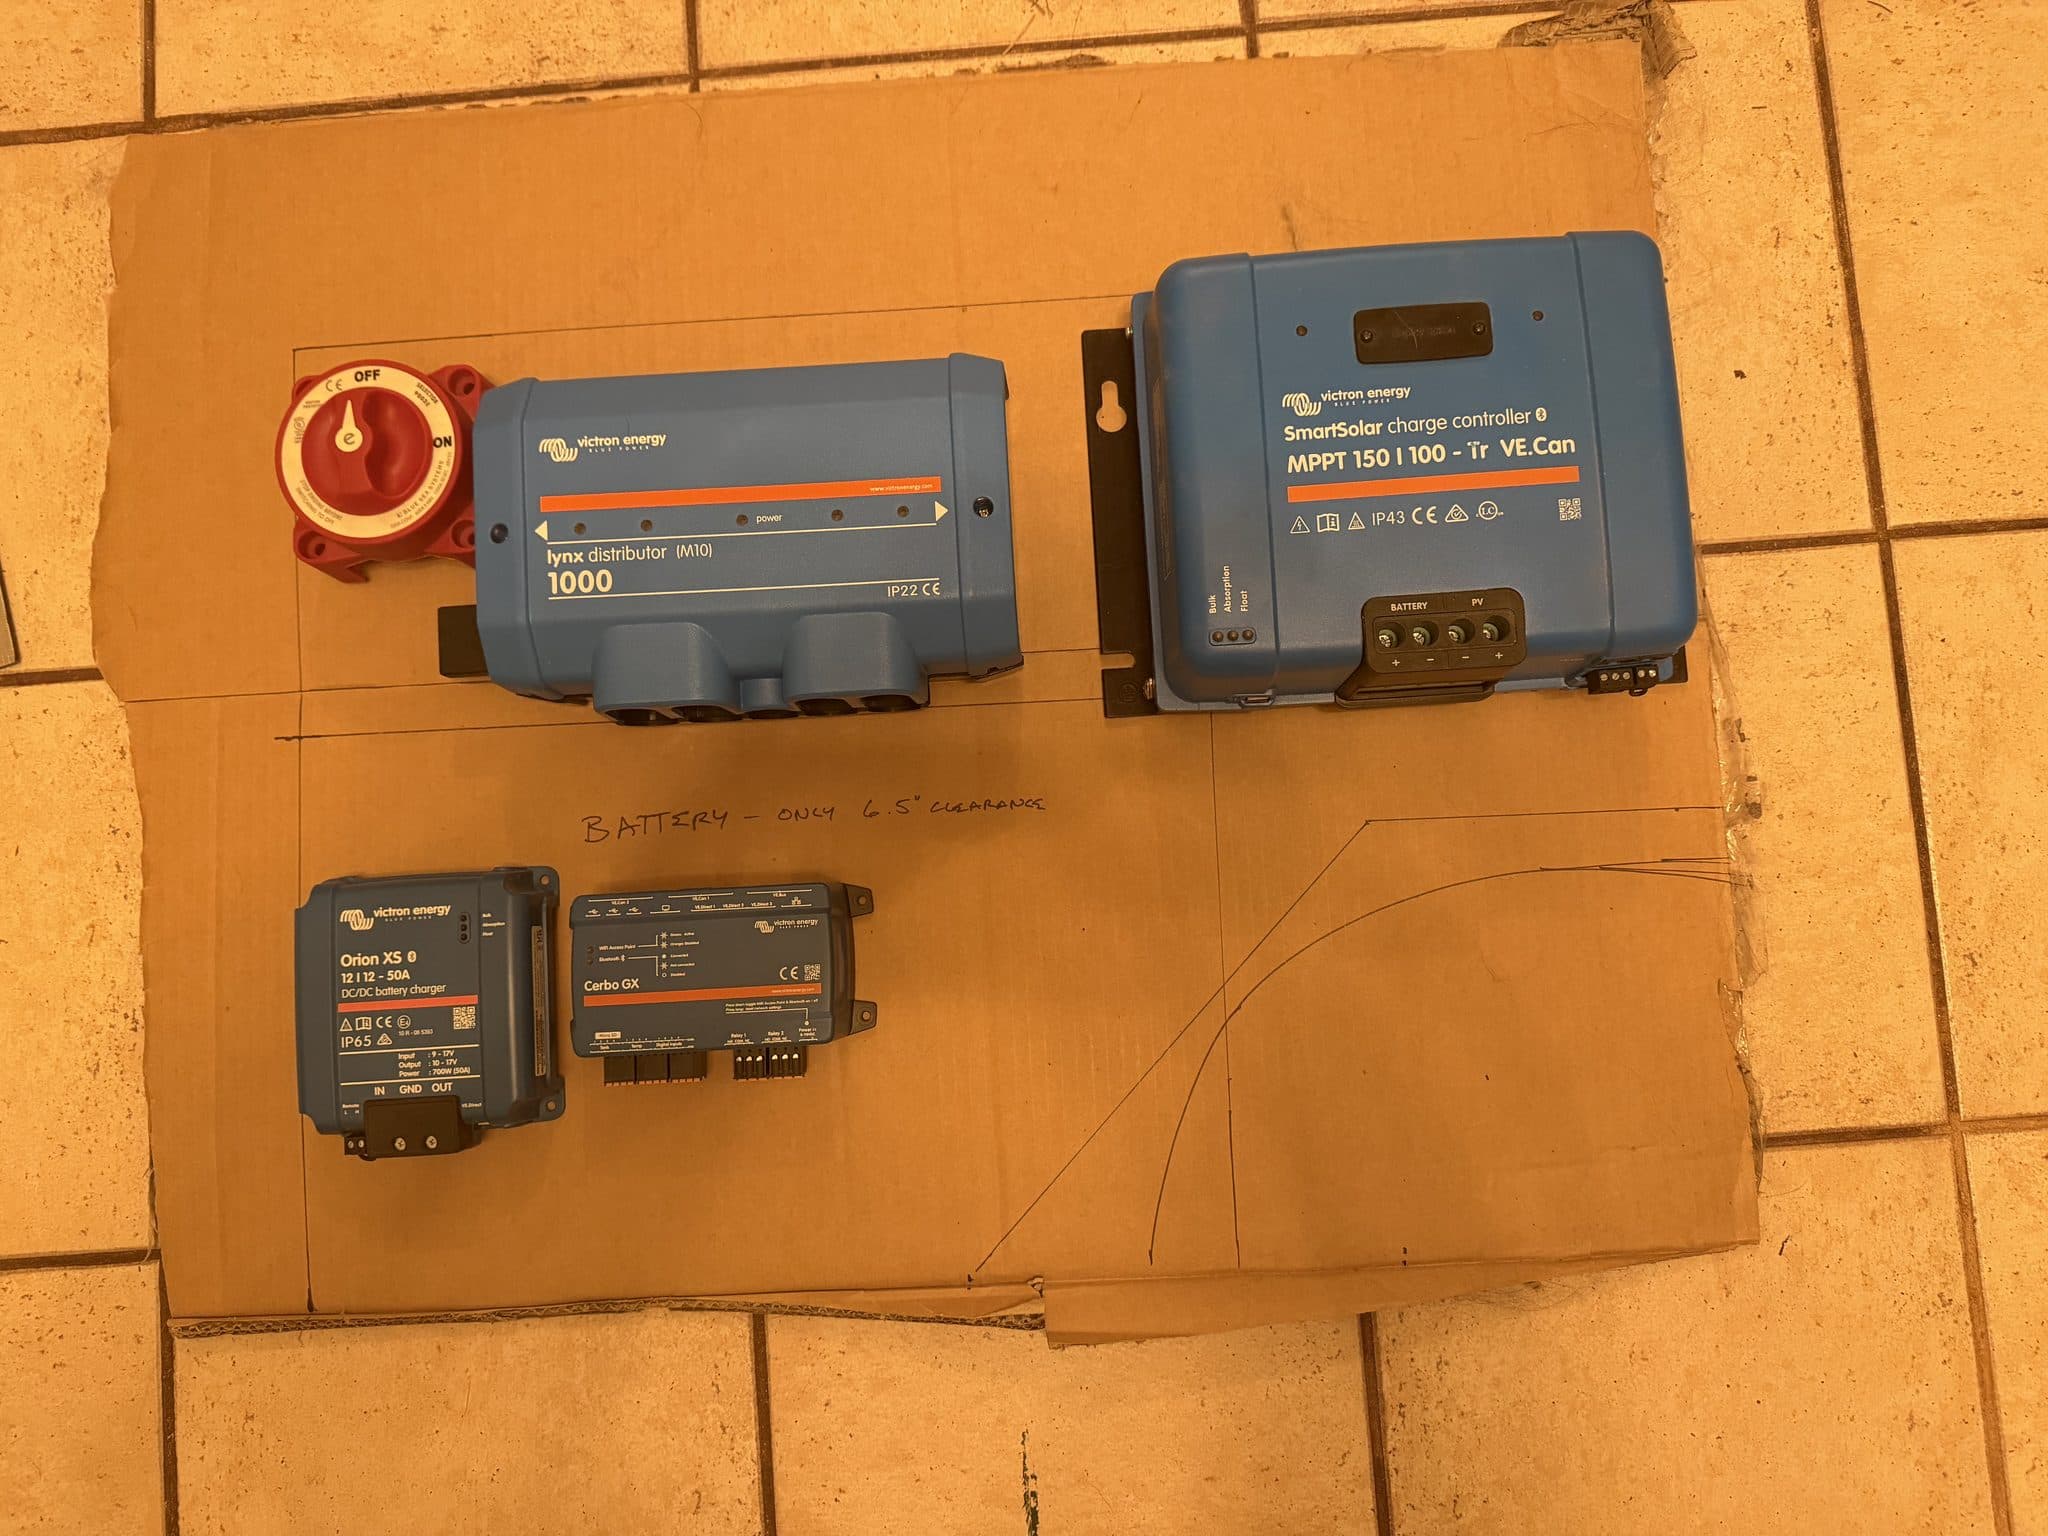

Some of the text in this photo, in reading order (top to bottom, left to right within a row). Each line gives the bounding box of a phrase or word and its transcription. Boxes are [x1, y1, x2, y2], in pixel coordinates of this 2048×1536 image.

[354, 369, 381, 383] OFF
[1321, 386, 1411, 402] victron energy
[1284, 407, 1532, 442] SmartSolar charge controller
[432, 435, 453, 448] ON
[577, 434, 667, 448] victron energy
[1287, 451, 1347, 473] MPPT
[1353, 448, 1391, 469] 150
[1408, 443, 1446, 465] 100
[1466, 440, 1489, 460] Tr
[1499, 436, 1576, 457] VE.Can
[756, 513, 783, 524] power
[1372, 511, 1406, 526] IP43
[547, 543, 713, 568] lynx distributor (M10)
[547, 569, 613, 595] 1000
[1222, 565, 1233, 613] Absorption
[887, 584, 919, 598] IP22
[1208, 594, 1217, 614] Bulk
[1240, 590, 1249, 612] Float
[1390, 598, 1484, 612] BATTERY PV
[581, 809, 728, 843] BATTERY
[777, 807, 834, 822] ONLY
[862, 795, 920, 818] 6.5"
[930, 798, 1046, 812] CLEARANCE
[374, 904, 451, 918] victron energy
[773, 918, 819, 928] victron energy
[340, 951, 402, 967] Orion XS
[341, 972, 353, 983] 12
[363, 971, 375, 983] 12
[387, 969, 411, 981] 50A
[341, 983, 447, 999] DC/DC battery charger
[584, 978, 640, 991] Cerbo GX
[341, 1034, 372, 1049] IP65
[399, 1061, 422, 1070] Output
[374, 1082, 453, 1096] IN GND OUT
